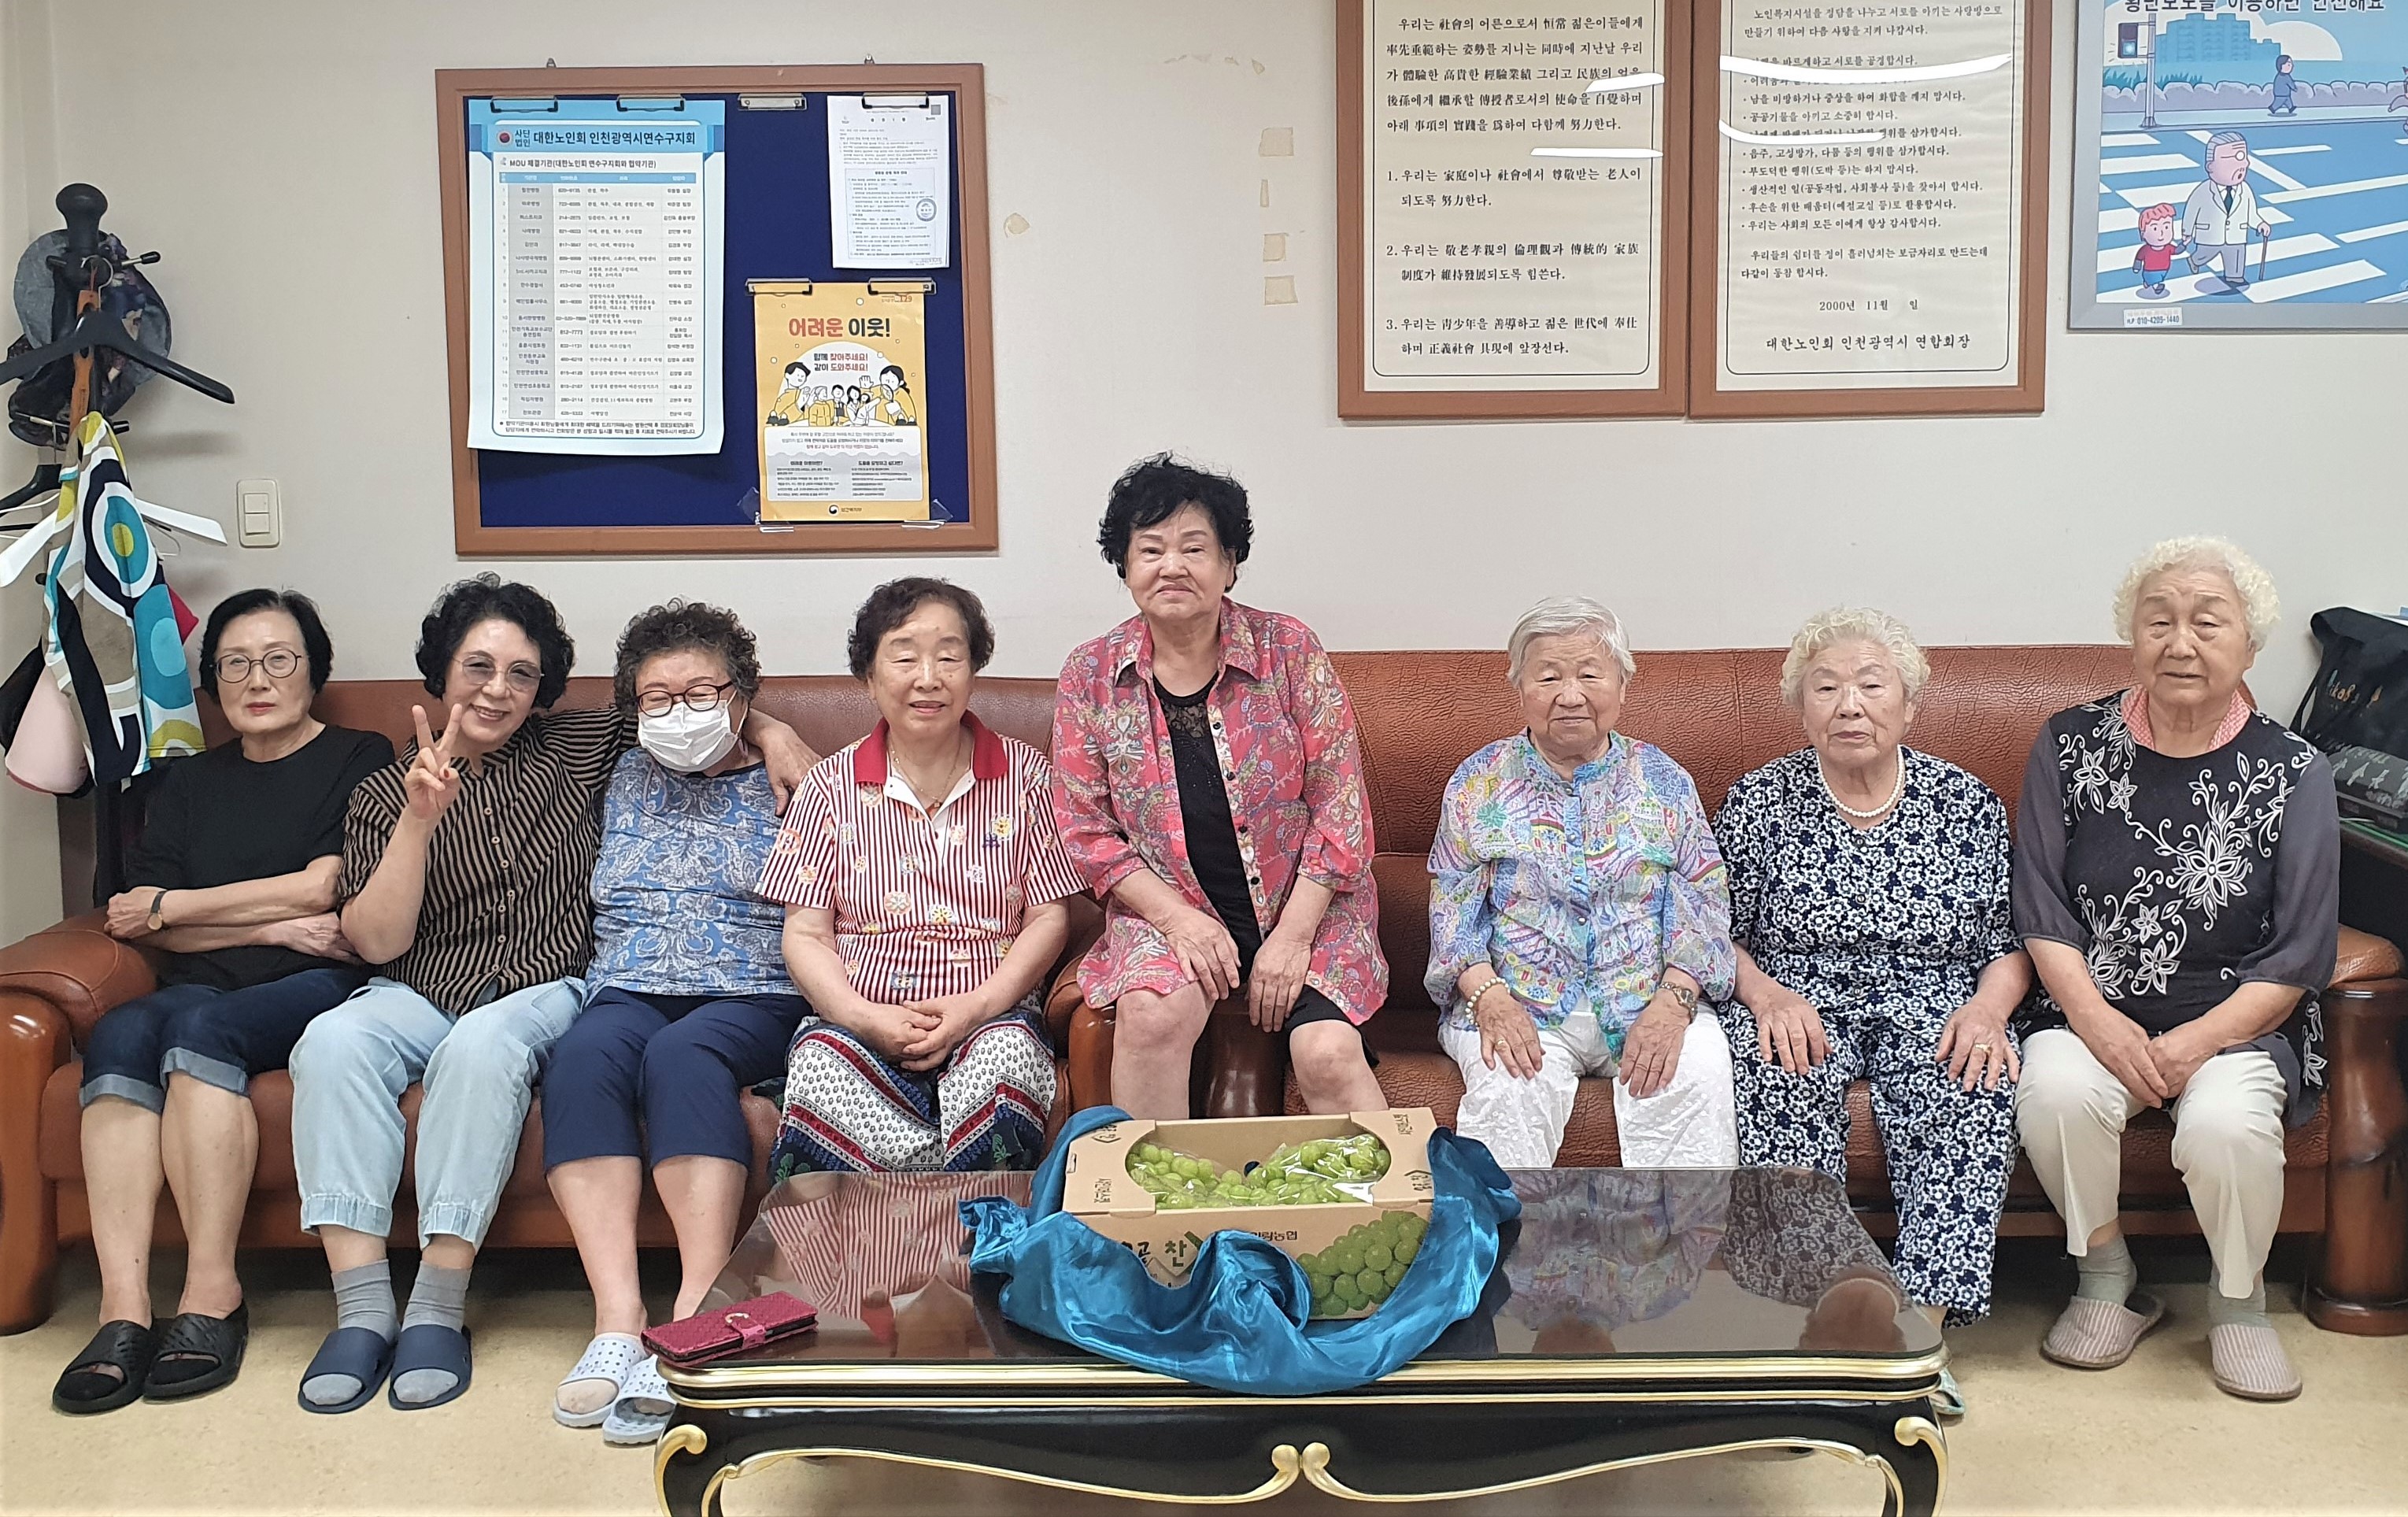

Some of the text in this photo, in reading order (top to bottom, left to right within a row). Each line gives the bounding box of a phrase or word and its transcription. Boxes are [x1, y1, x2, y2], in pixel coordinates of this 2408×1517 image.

[1753, 7, 1822, 20] 노인복지시설을
[1857, 6, 1887, 18] 나누고
[1889, 6, 1918, 17] 서로를
[1922, 6, 1951, 17] 아끼는
[1954, 5, 2003, 17] 사랑방으로
[1398, 17, 1435, 31] 우리는
[1439, 17, 1474, 31] 社會의
[1543, 17, 1567, 30] 恒常
[1744, 24, 1928, 39] 만들기 위하여 다음 사항을 지켜 나갑시다.
[1500, 42, 1537, 56] 지니는
[1541, 42, 1575, 55] 同時에
[1580, 41, 1616, 55] 지난날
[1620, 41, 1642, 55] 우리
[1833, 55, 1864, 67] 서로를
[1866, 54, 1918, 68] 공경합시다.
[1386, 68, 1399, 83] 가
[1536, 67, 1573, 81] 그리고
[1387, 93, 1433, 108] 後孫에게
[1555, 92, 1592, 106] 使命을
[1594, 91, 1641, 105] 自覺하며
[1750, 90, 1966, 105] 남을 비방하거나 중상을 하여 화합을 깨지 맙시다.
[1833, 109, 1862, 121] 소중히
[1866, 109, 1898, 121] 합시다.
[1387, 119, 1409, 133] 아래
[1414, 118, 1448, 132] 事項의
[1530, 117, 1565, 131] 다함께
[1570, 117, 1621, 131] 努力한다.
[1910, 126, 1962, 139] 삼가합시다.
[515, 129, 531, 139] 사단
[533, 131, 696, 145] 대한노인회 인천광역시연수구지회
[1844, 146, 1862, 157] 등의
[1866, 146, 1895, 157] 행위를
[1898, 144, 1949, 157] 삼가합시다.
[1388, 170, 1398, 182] 1.
[1401, 168, 1438, 183] 우리는
[1443, 168, 1492, 182] 家庭이나
[1497, 168, 1544, 182] 社會에서
[1605, 167, 1640, 180] 老人이
[1748, 165, 1788, 177] 부도덕한
[1837, 165, 1862, 176] 등)는
[1864, 163, 1882, 175] 하지
[1886, 163, 1918, 175] 맙시다.
[1748, 183, 1787, 195] 생산적인
[1891, 181, 1915, 193] 등)을
[1918, 180, 1946, 193] 찾아서
[1951, 180, 1983, 192] 합시다.
[1400, 193, 1492, 208] 되도록 努力한다.
[1781, 201, 1800, 213] 위한
[1748, 216, 1941, 231] 우리는 사회의 모든 이에게 항상 감사합시다.
[1386, 245, 1398, 257] 2.
[1400, 243, 1440, 257] 우리는
[1570, 242, 1607, 256] 傳統的
[1614, 242, 1639, 255] 家族
[1750, 250, 1788, 261] 우리들의
[1824, 248, 1844, 260] 정이
[1526, 267, 1566, 281] 힘쓴다.
[1740, 266, 1828, 279] 다같이 동참 합시다.
[1819, 298, 1918, 312] 2000년 11월 일
[789, 317, 891, 338] 어려운 이웃!
[1385, 319, 1398, 331] 3.
[1400, 317, 1437, 331] 우리는
[1544, 316, 1569, 330] 젊은
[1574, 316, 1608, 330] 世代에
[1615, 316, 1637, 329] 奉仕
[1400, 342, 1422, 356] 하며
[1429, 342, 1474, 355] 正義社會
[1518, 341, 1569, 355] 앞장선다.
[1766, 333, 1970, 352] 대한노인회 인천광역시 연합회장
[813, 353, 829, 361] 함께
[813, 363, 868, 372] 같이 도와주세요!
[1164, 1240, 1188, 1267] 찬
